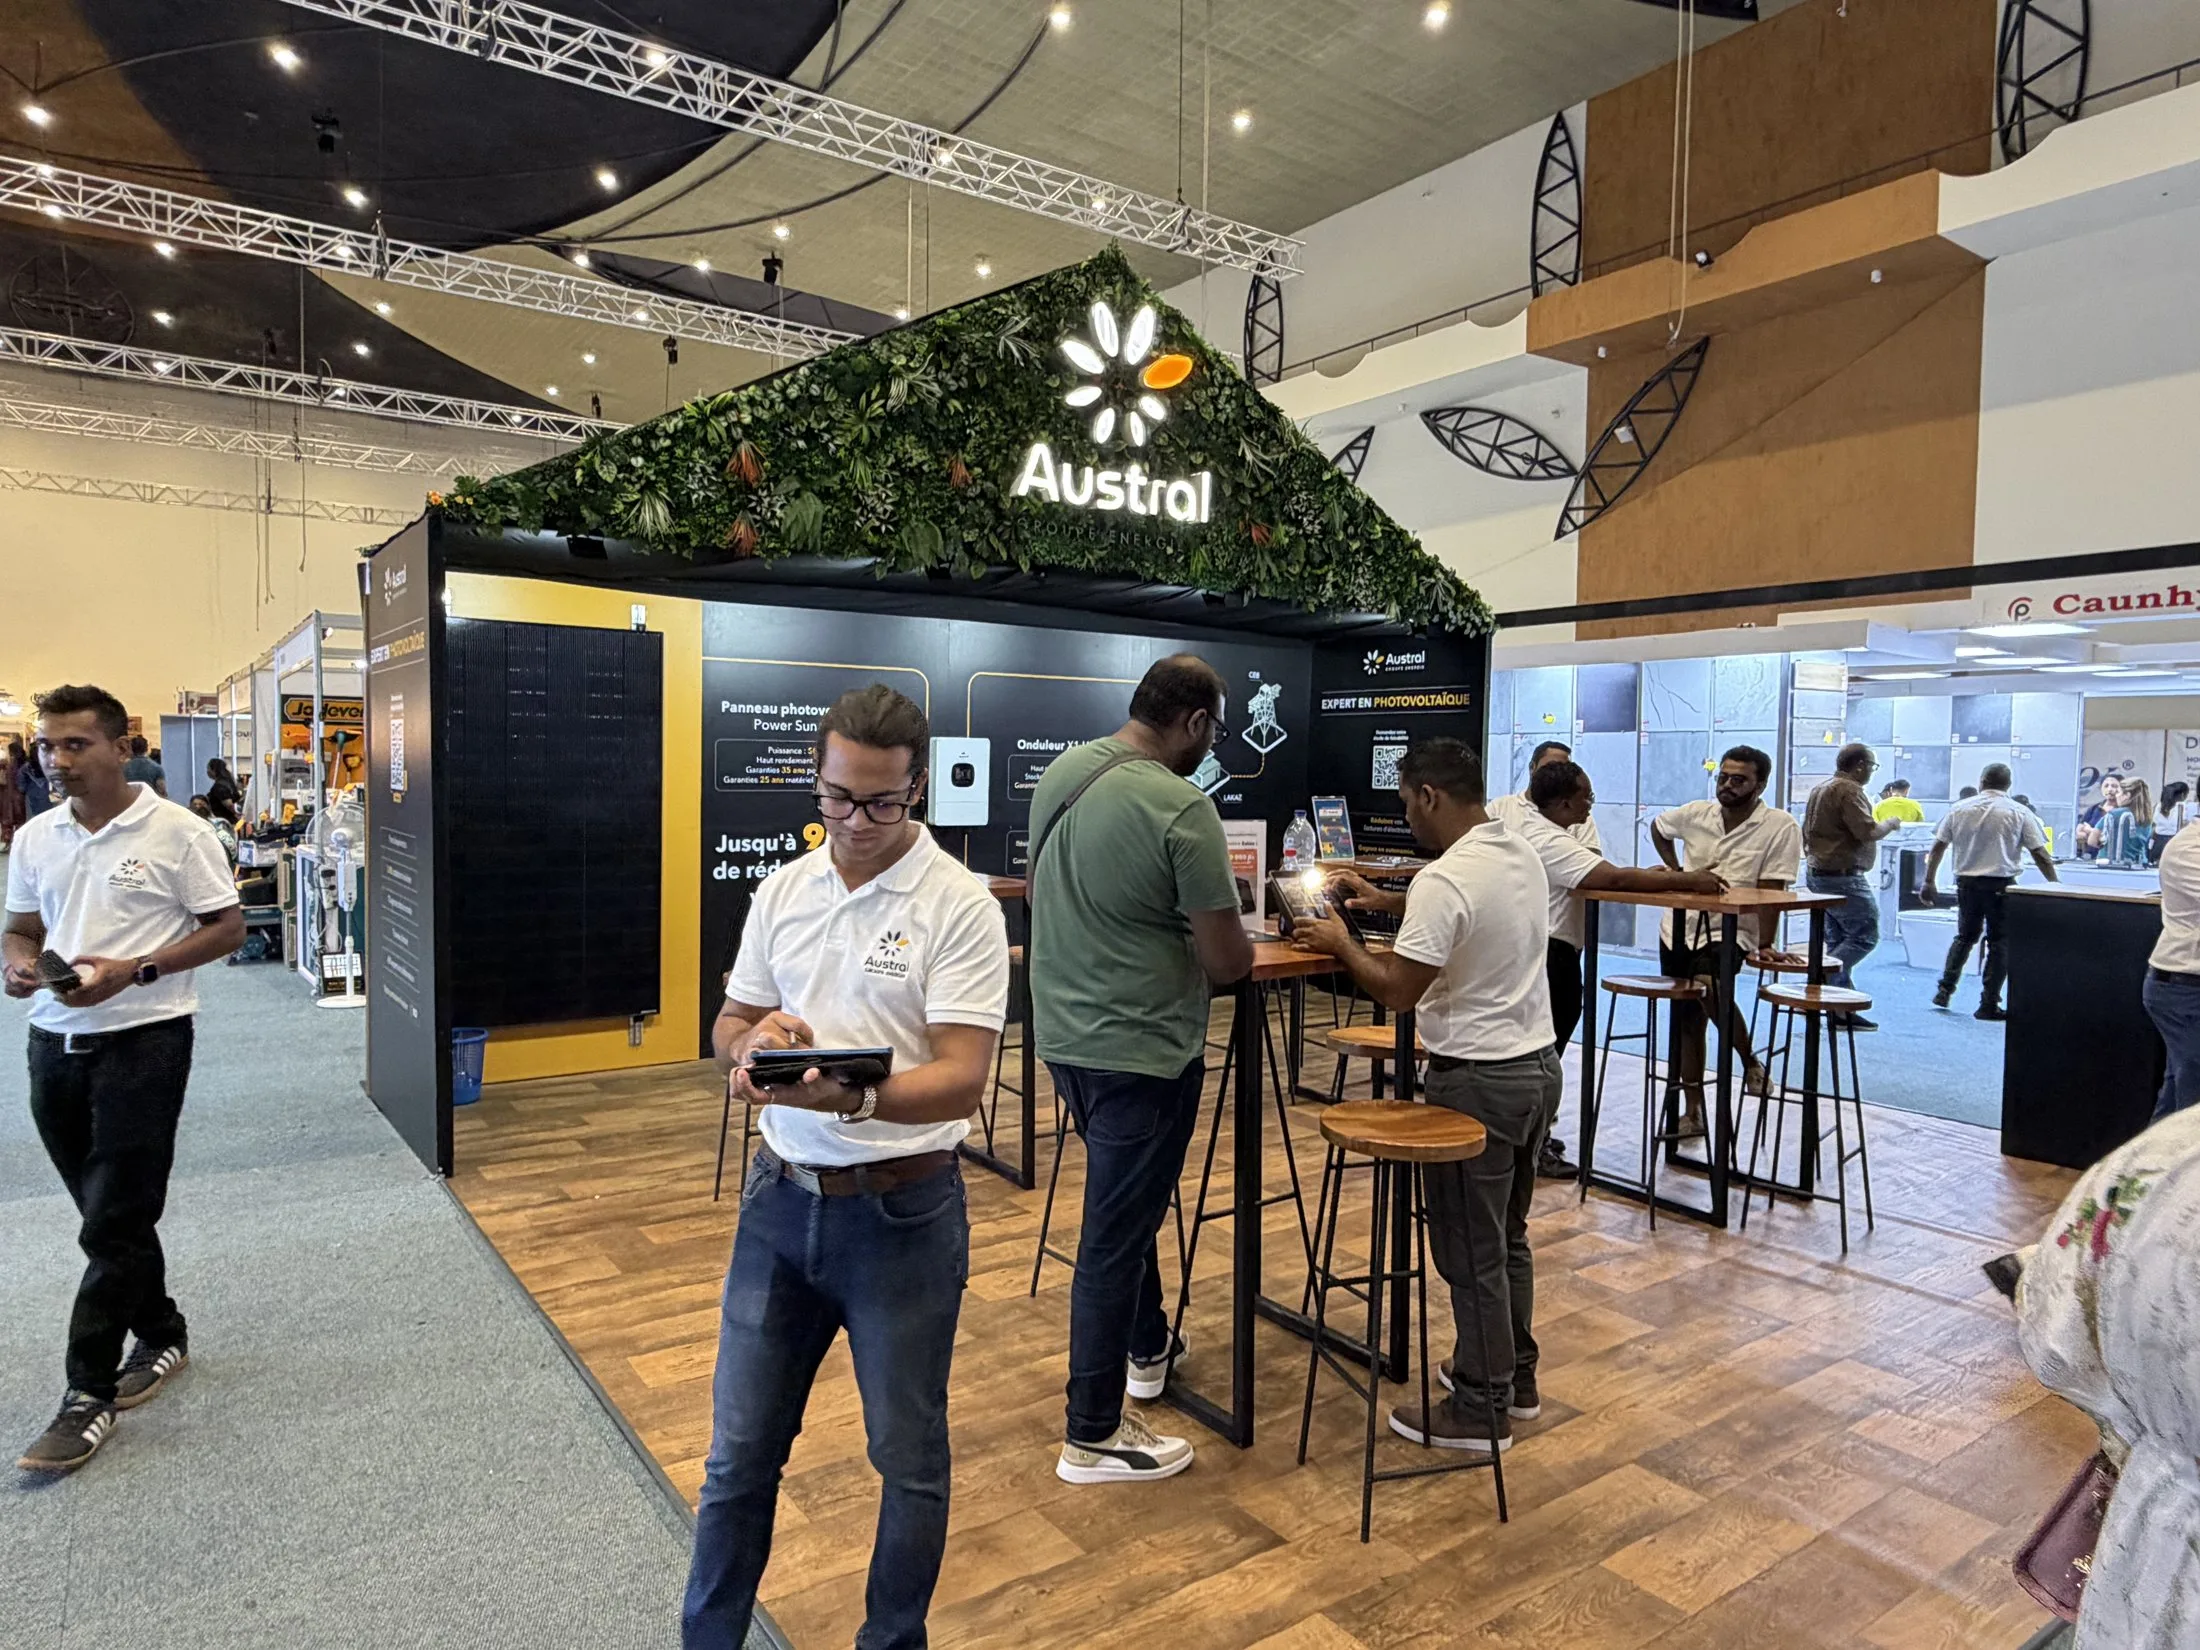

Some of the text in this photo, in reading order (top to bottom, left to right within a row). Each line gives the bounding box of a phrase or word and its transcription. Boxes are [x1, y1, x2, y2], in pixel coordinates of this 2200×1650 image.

[1014, 443, 1211, 523] Austral
[2053, 585, 2200, 614] Caunh
[1386, 650, 1425, 665] Austral
[1321, 692, 1470, 709] EXPERT EN PHOTOVOLTAÏQUE
[721, 701, 830, 717] Panneau photov
[754, 719, 817, 731] Power Sun
[1017, 739, 1064, 750] Onduleur
[746, 766, 779, 774] Garanties
[724, 776, 758, 784] Garanties
[715, 823, 825, 856] Jusqu'à 9
[713, 859, 784, 879] de réd
[864, 956, 909, 972] Austral
